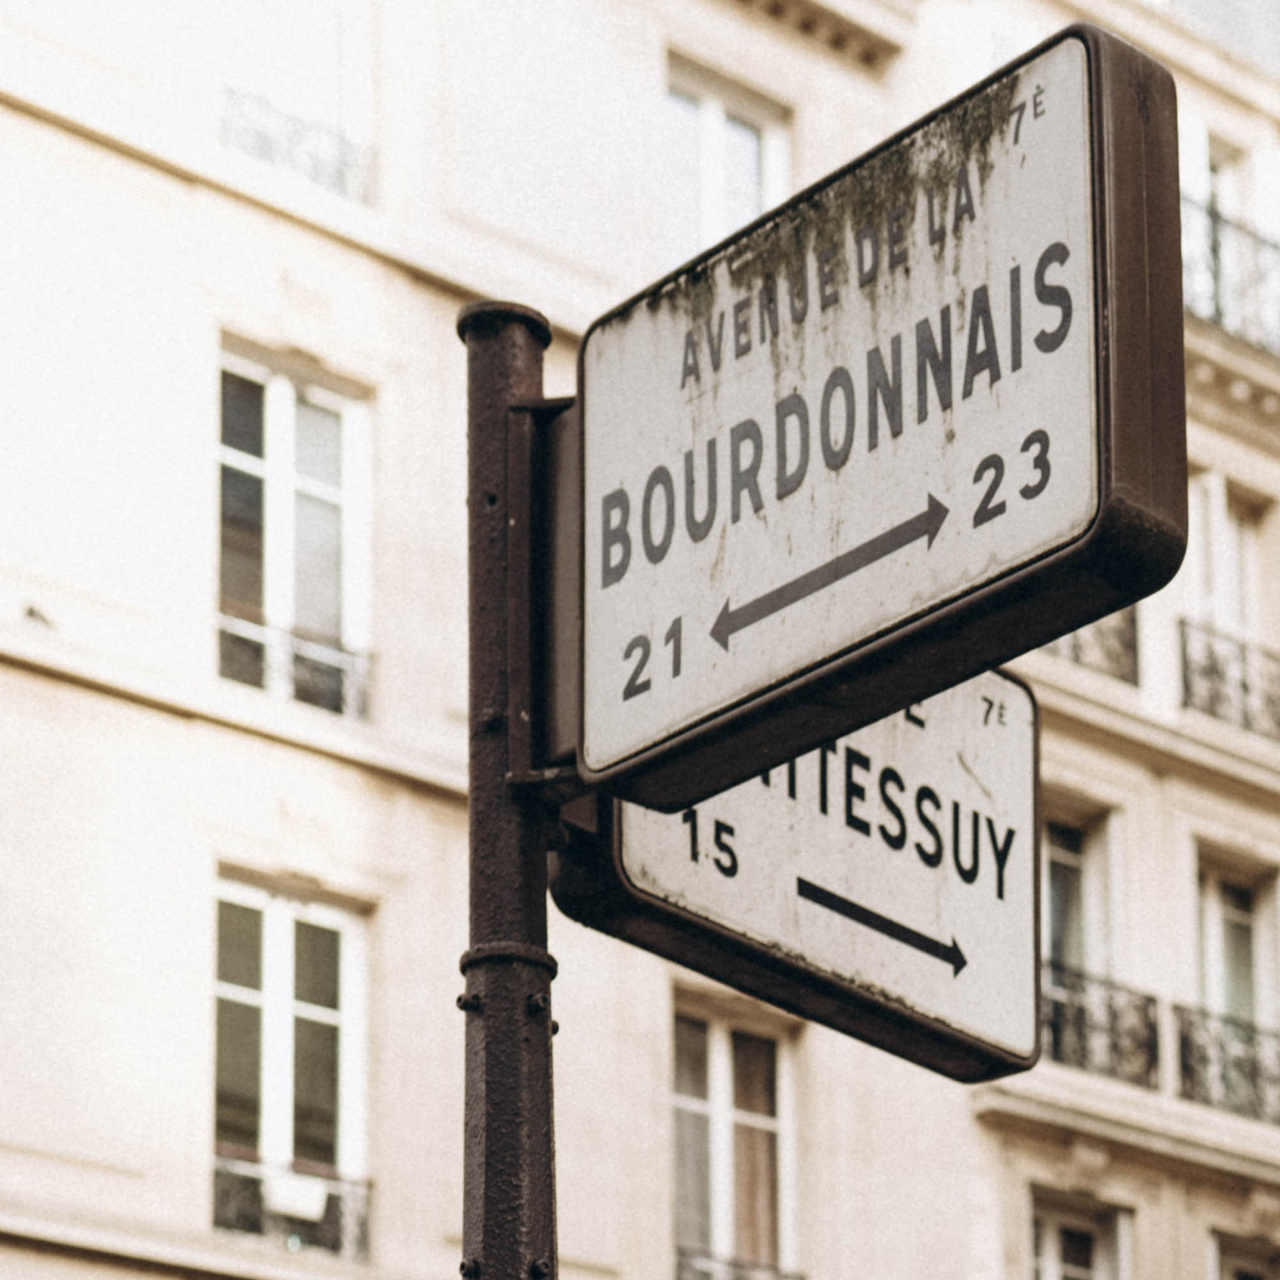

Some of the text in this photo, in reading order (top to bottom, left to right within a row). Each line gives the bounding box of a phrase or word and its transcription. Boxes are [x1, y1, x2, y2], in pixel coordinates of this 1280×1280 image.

[681, 166, 977, 390] AVENUE DE LA
[602, 241, 1073, 589] BOURDONNAIS
[972, 429, 1052, 529] 23
[623, 616, 682, 701] 21
[682, 807, 738, 878] 15
